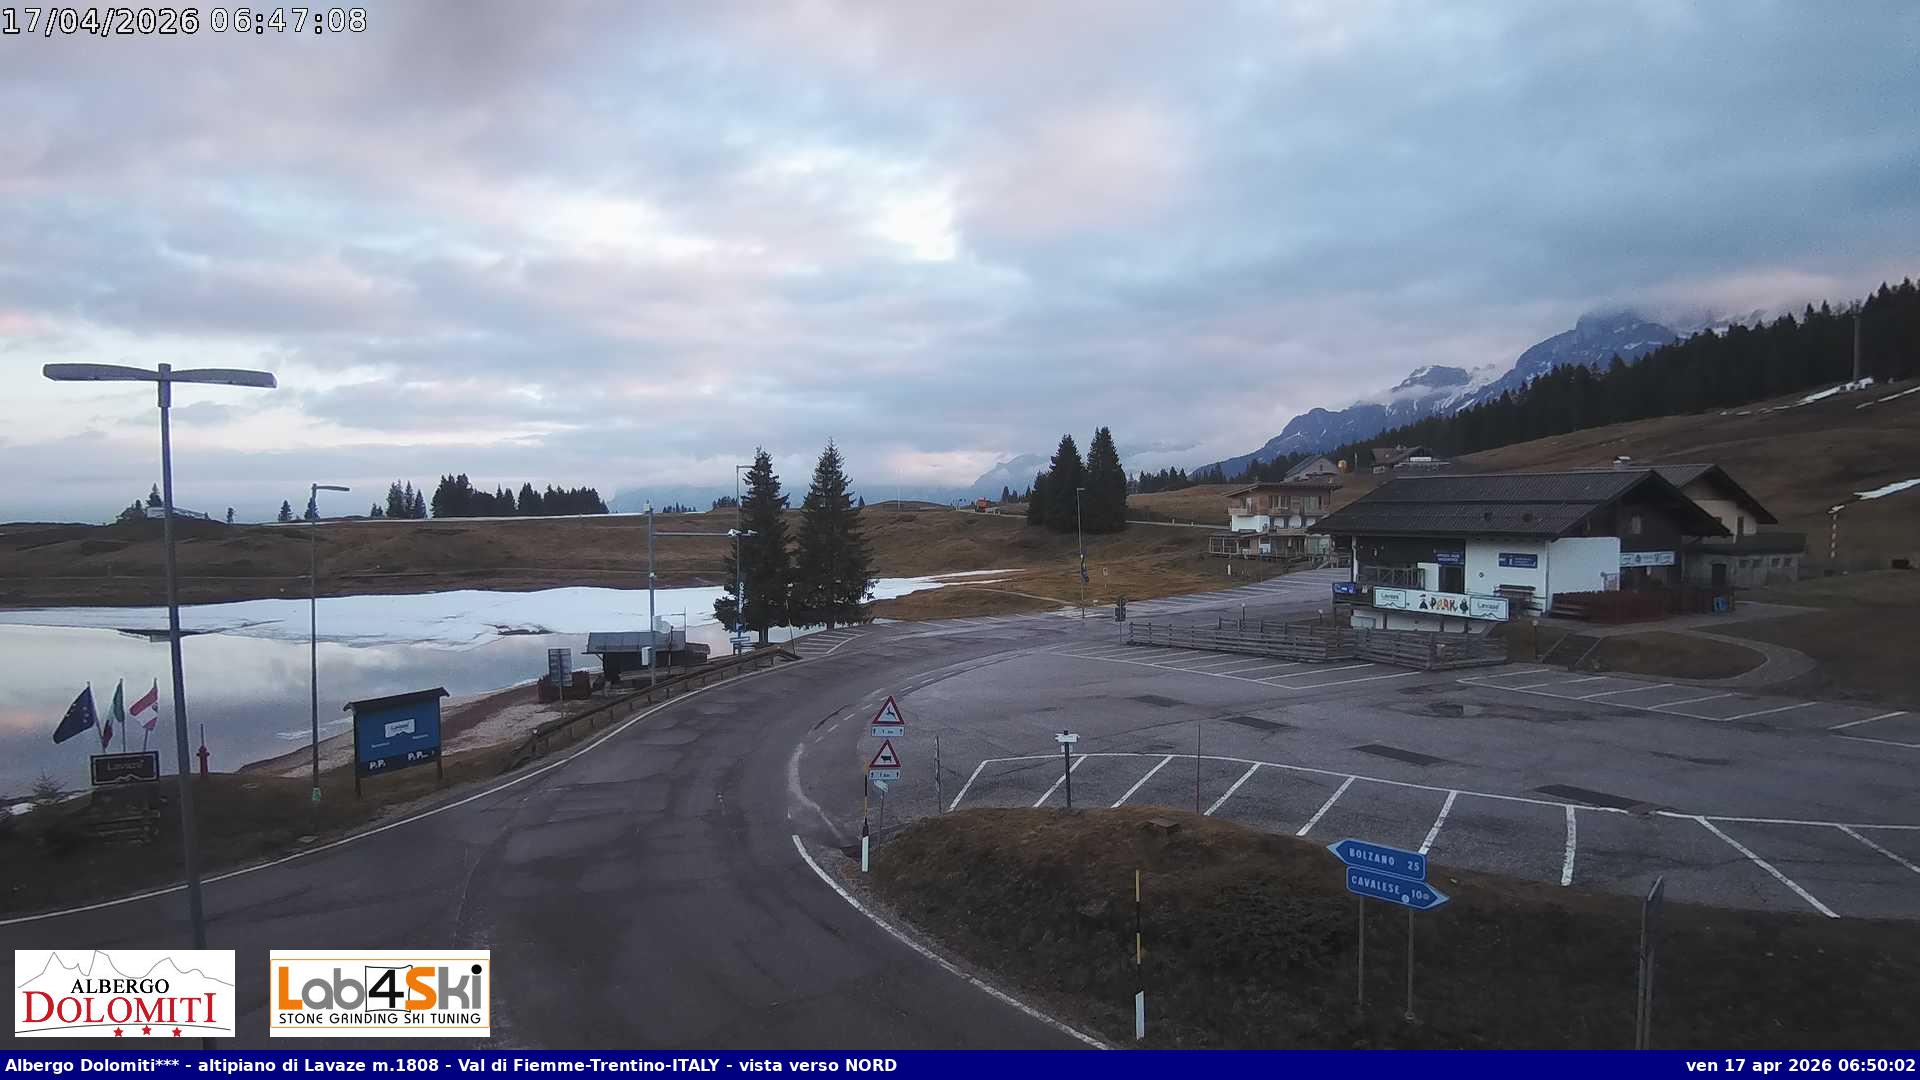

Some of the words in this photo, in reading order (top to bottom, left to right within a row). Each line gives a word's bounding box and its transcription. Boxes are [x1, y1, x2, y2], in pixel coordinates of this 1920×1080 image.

[1349, 847, 1396, 866] BOLZANO
[1407, 860, 1420, 872] 25
[1351, 874, 1401, 895] CAVALESE
